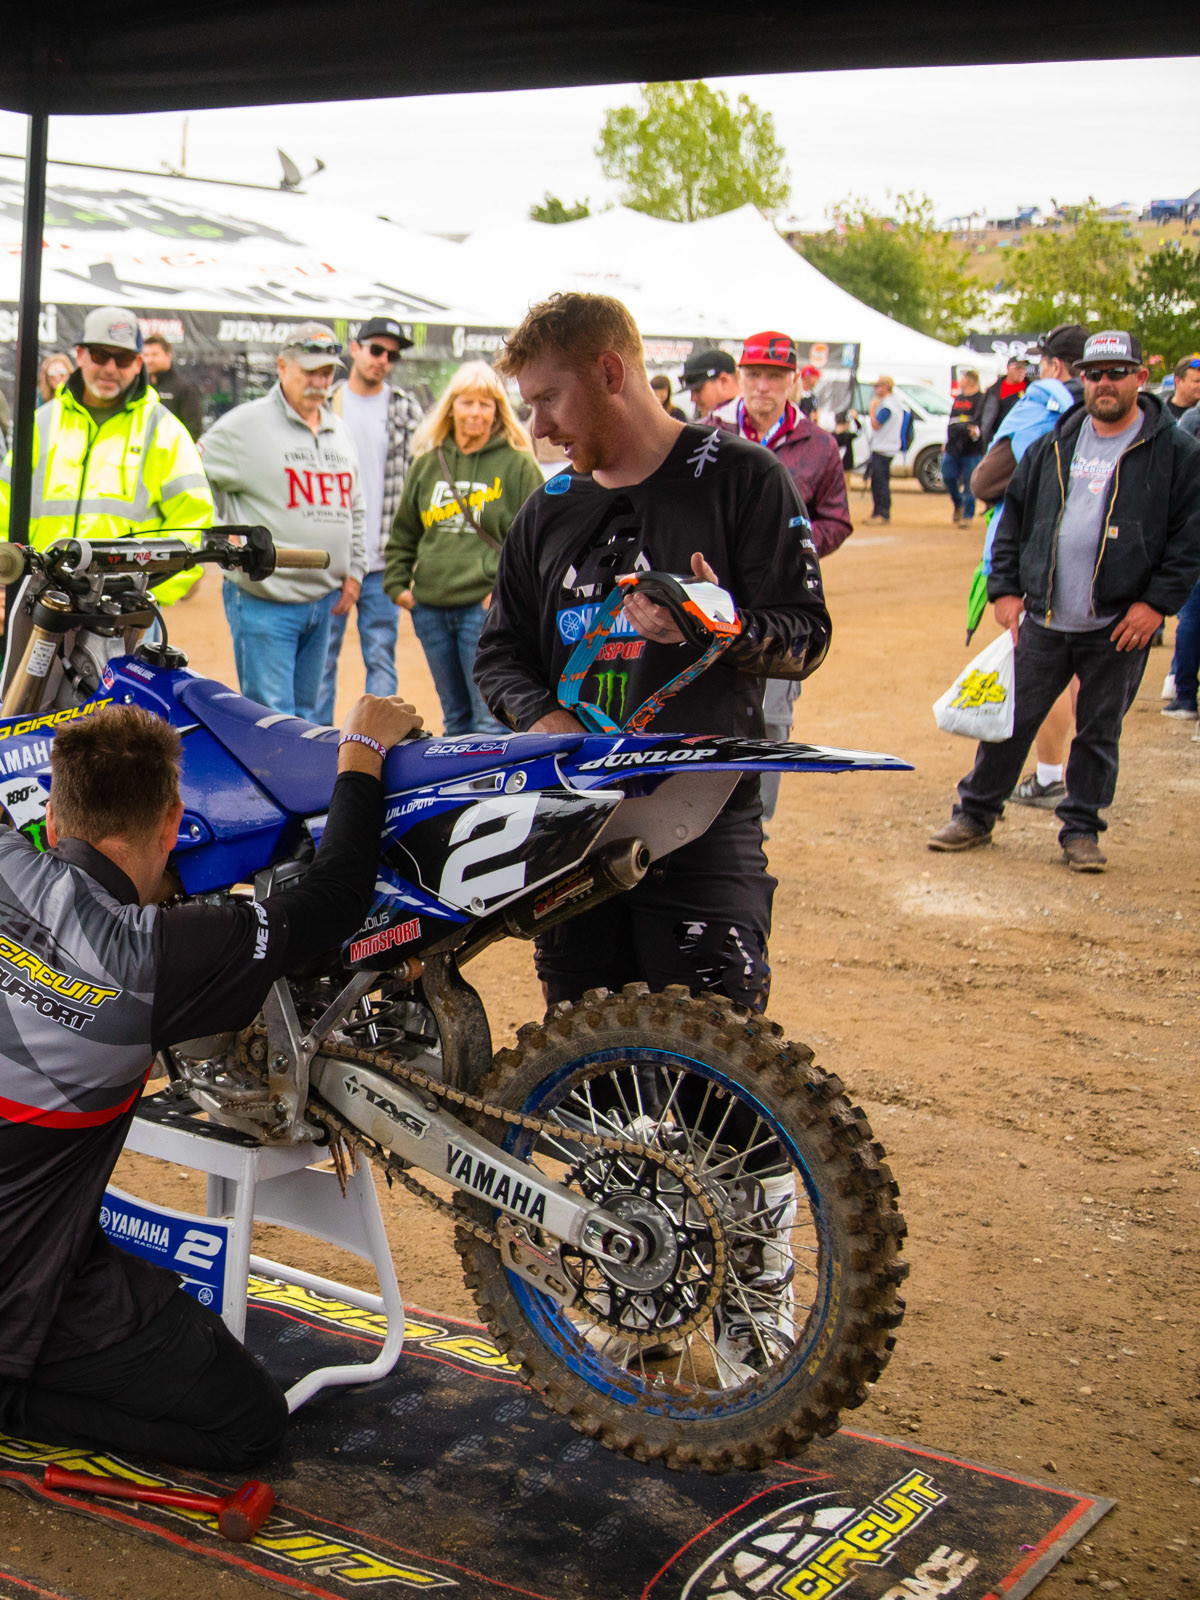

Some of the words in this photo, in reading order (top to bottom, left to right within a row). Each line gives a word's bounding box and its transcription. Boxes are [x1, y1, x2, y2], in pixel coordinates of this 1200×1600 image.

[12, 698, 114, 736] CIRCUIT
[578, 748, 717, 771] DUNLOP
[438, 792, 541, 911] 2
[360, 1083, 428, 1137] TAG
[446, 1141, 548, 1224] YAMAHA
[112, 1211, 170, 1248] YAMAHA
[133, 1239, 169, 1253] RACING
[174, 1229, 224, 1271] 2
[772, 1467, 948, 1600] CIRCUIT
